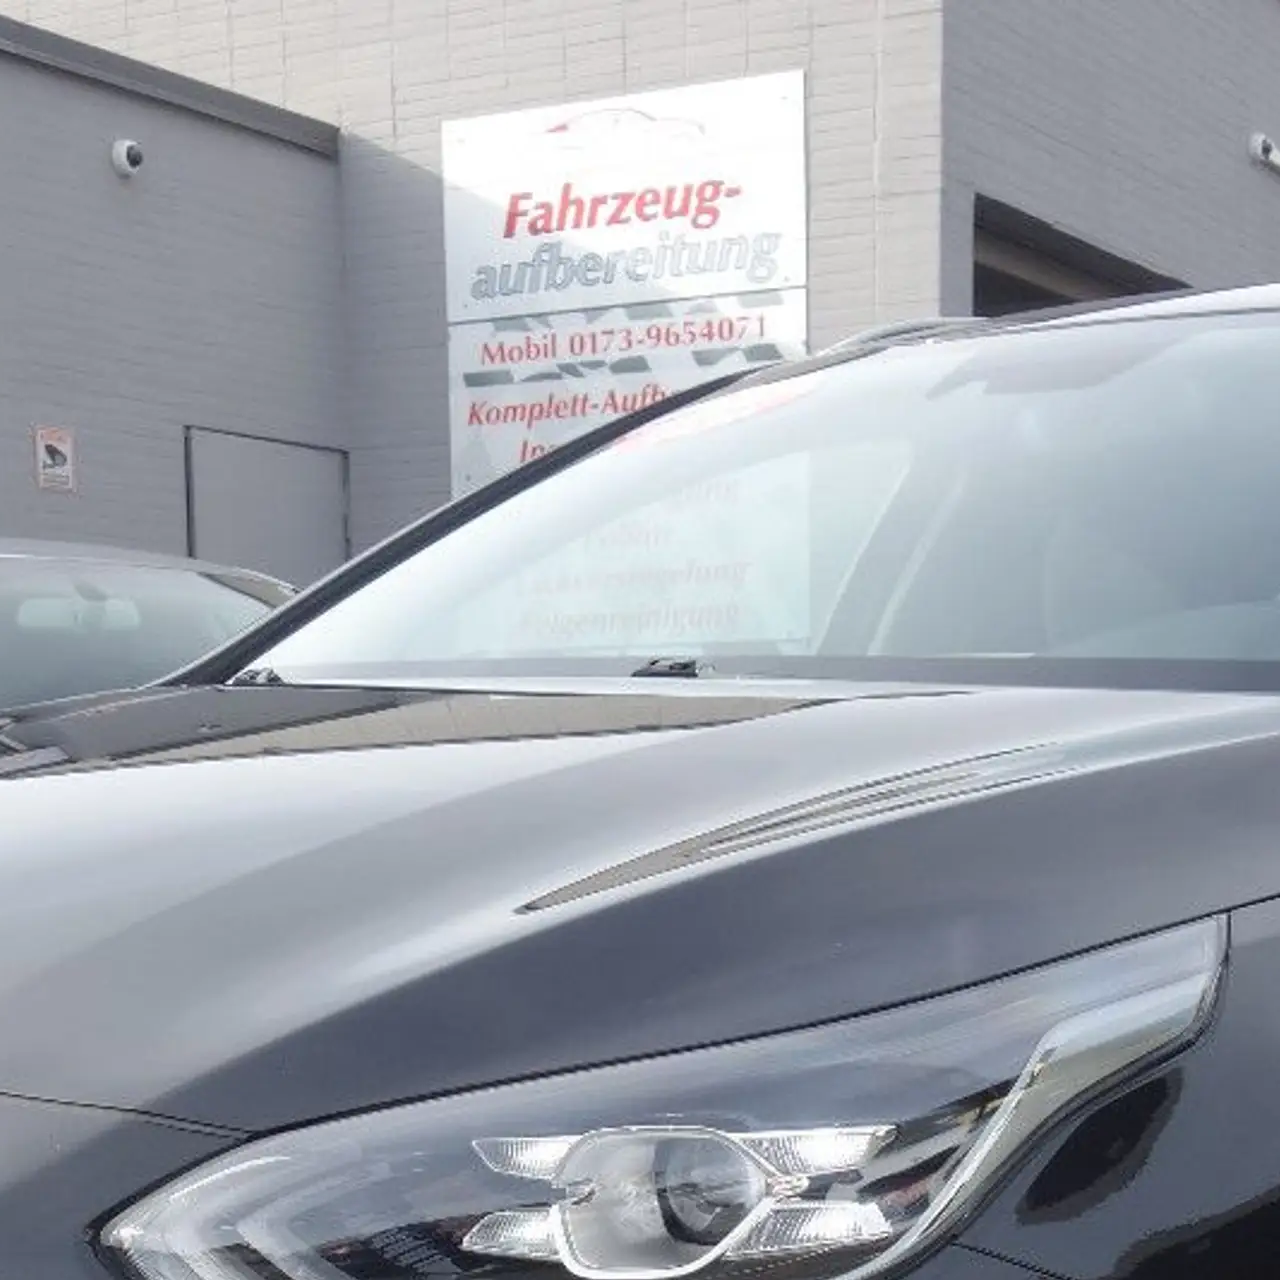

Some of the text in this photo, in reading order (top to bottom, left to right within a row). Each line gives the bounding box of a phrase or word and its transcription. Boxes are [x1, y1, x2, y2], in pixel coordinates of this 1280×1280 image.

[503, 180, 742, 239] Fahrzeug-
[470, 231, 783, 301] aufbereitung
[480, 313, 767, 367] Mobil 0173-9654071
[467, 381, 670, 428] Komplett-Aufb
